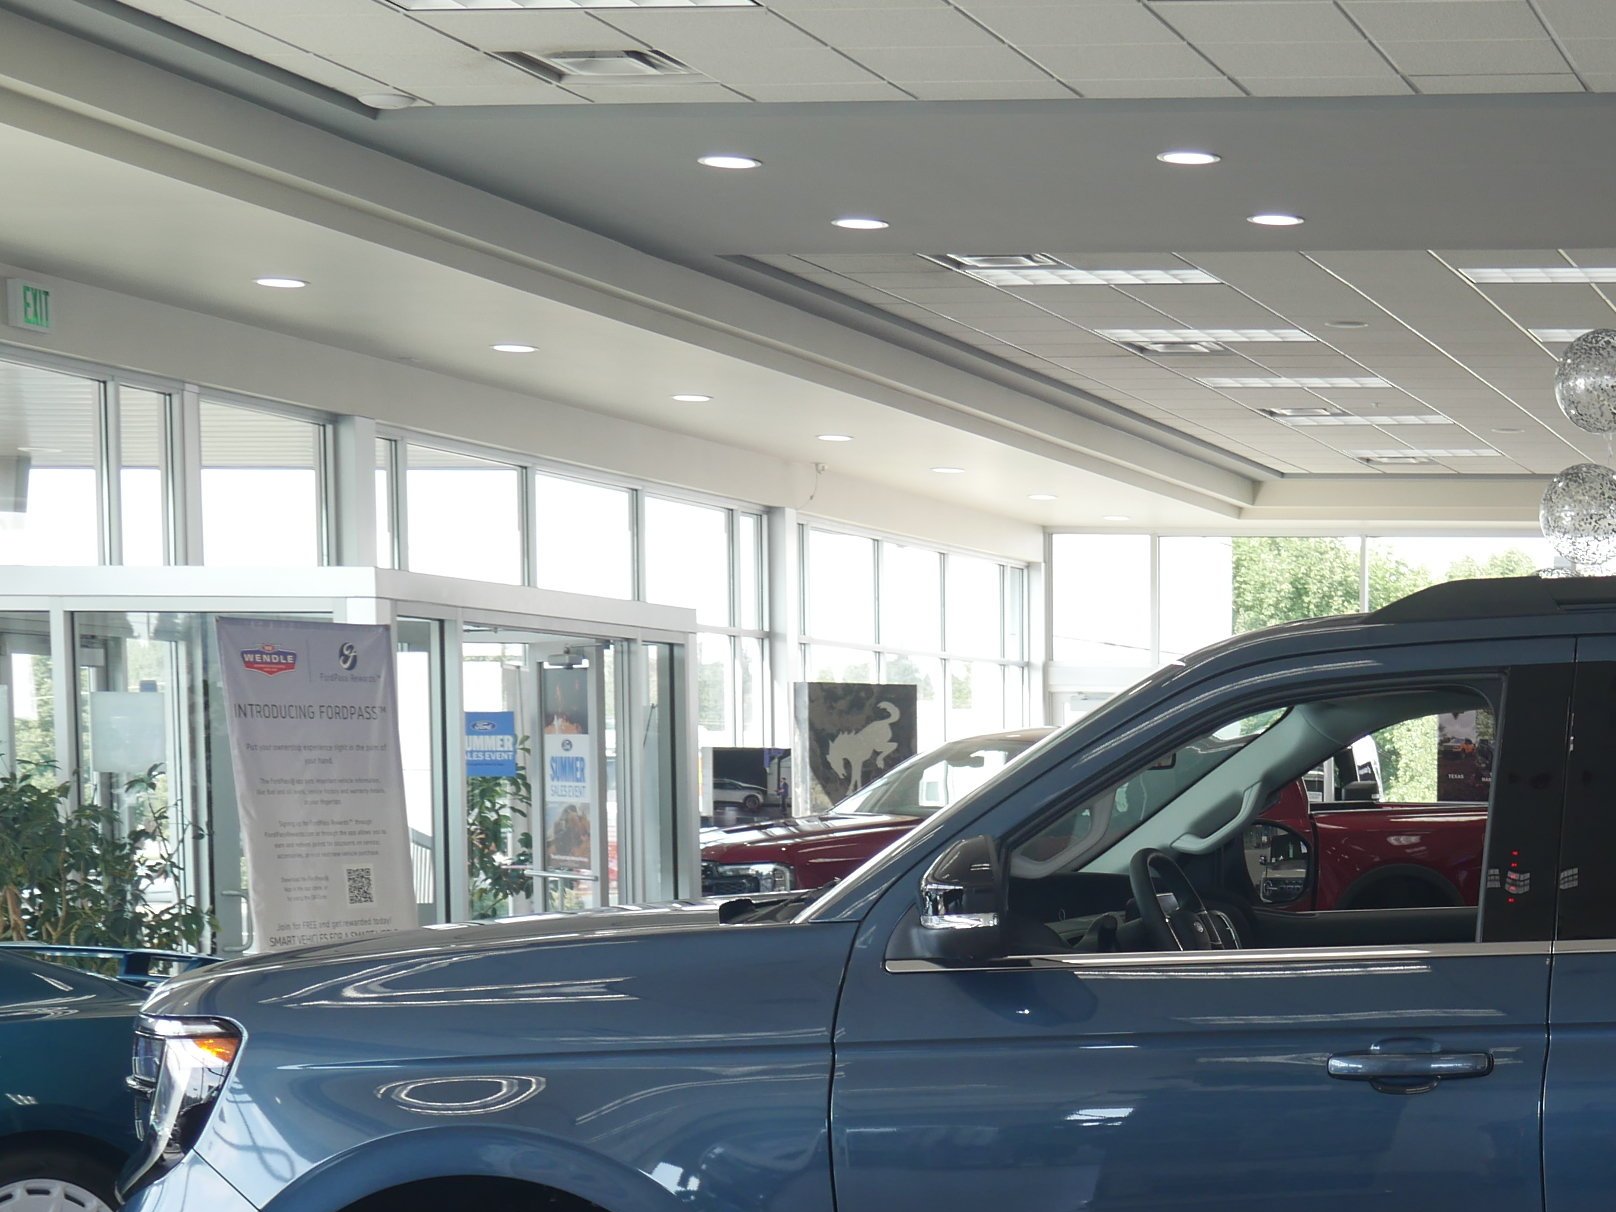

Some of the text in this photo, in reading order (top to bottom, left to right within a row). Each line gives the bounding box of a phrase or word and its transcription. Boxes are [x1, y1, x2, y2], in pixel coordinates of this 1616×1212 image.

[23, 286, 49, 328] EXIT
[244, 653, 294, 664] WENDLE
[234, 703, 315, 719] INTRODUCING
[465, 735, 513, 750] UMMER
[465, 752, 513, 760] LES EVENT
[550, 756, 585, 782] SUMMER
[302, 920, 317, 929] FREE
[270, 935, 297, 947] SMART
